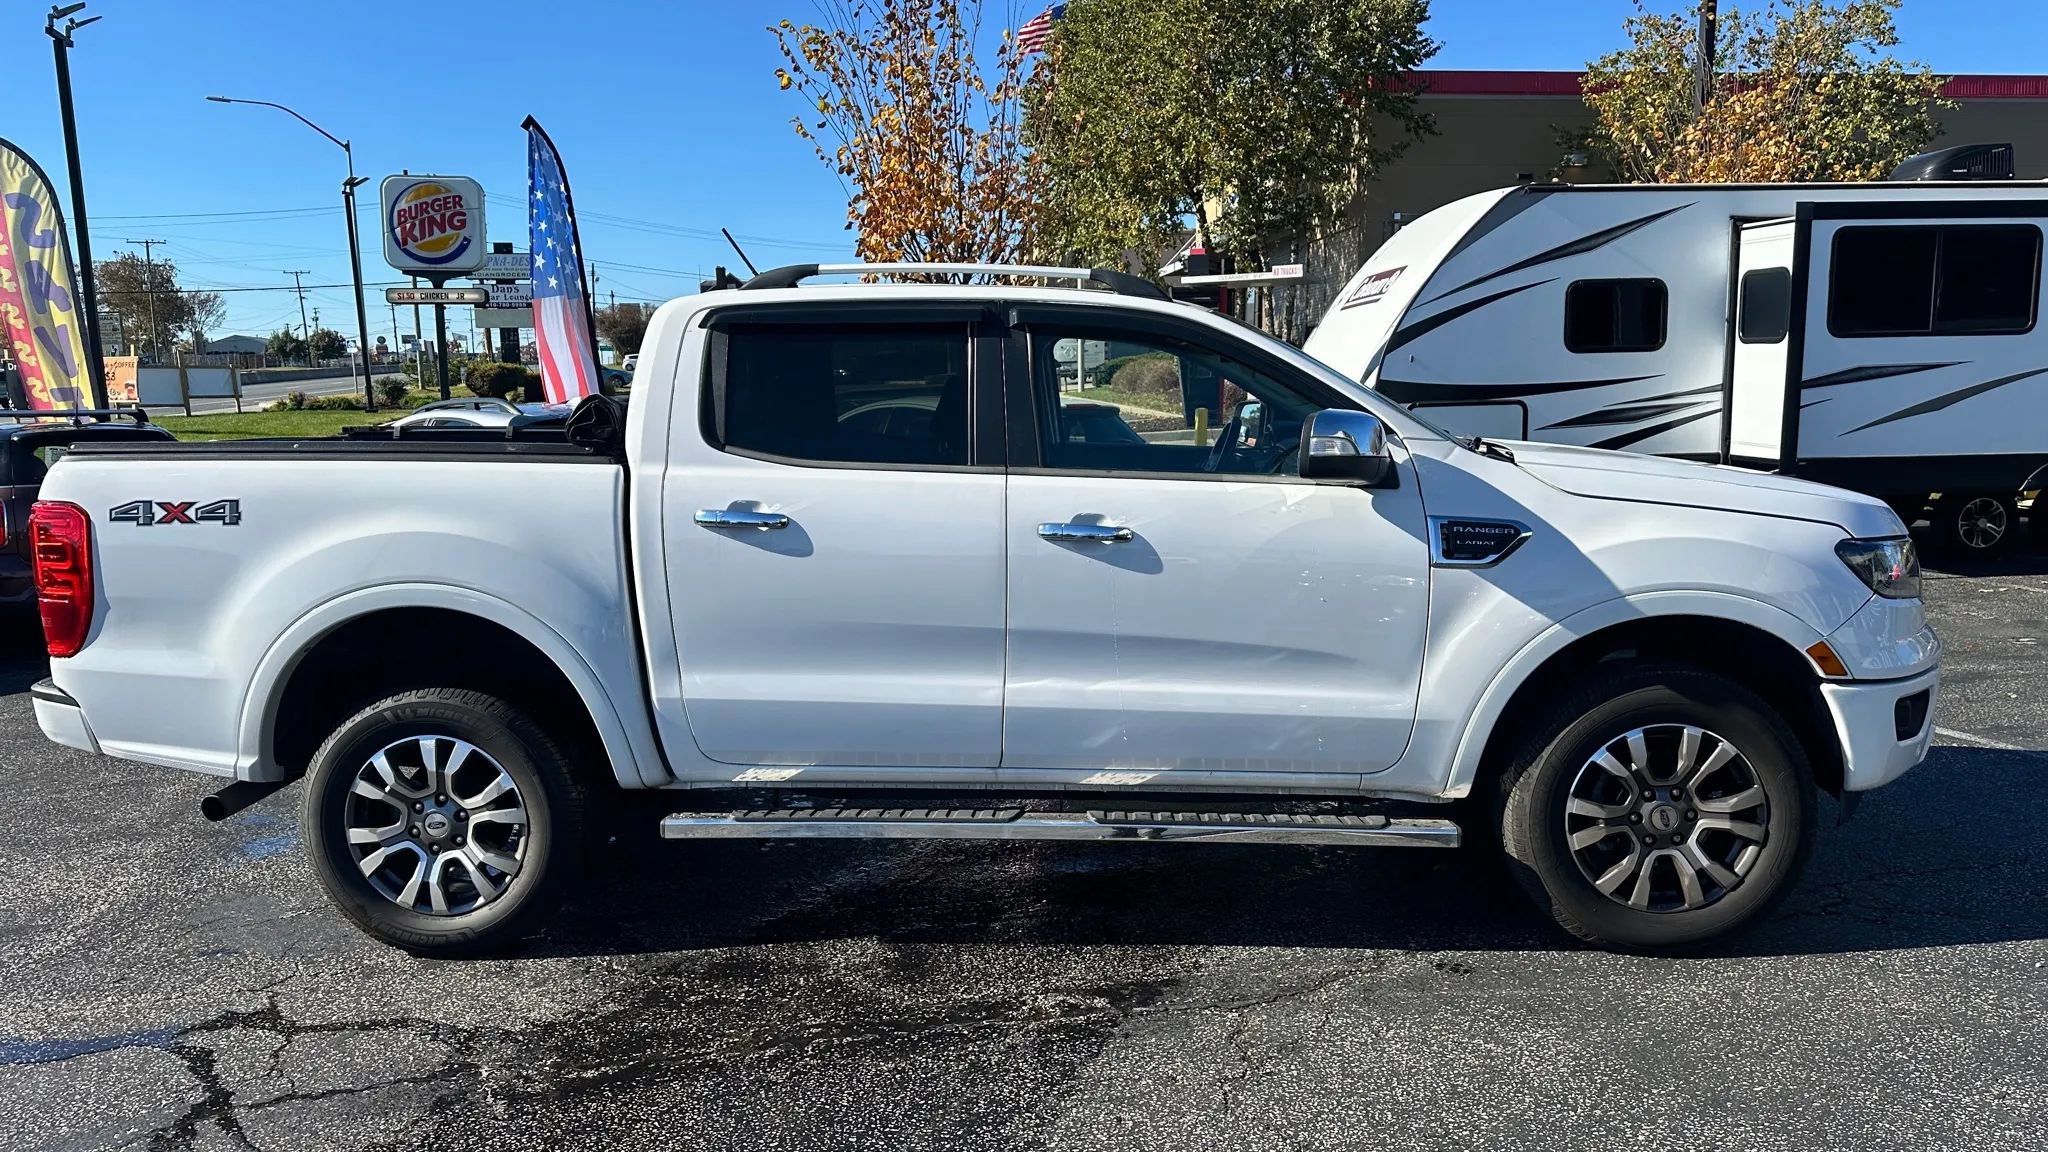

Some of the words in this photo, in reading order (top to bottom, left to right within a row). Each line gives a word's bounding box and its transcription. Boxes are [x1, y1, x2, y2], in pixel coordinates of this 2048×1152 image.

[397, 195, 463, 225] BURGER
[400, 211, 467, 248] KING
[420, 292, 449, 300] CHICKEN
[456, 292, 464, 300] JR
[1453, 526, 1514, 534] RANGER
